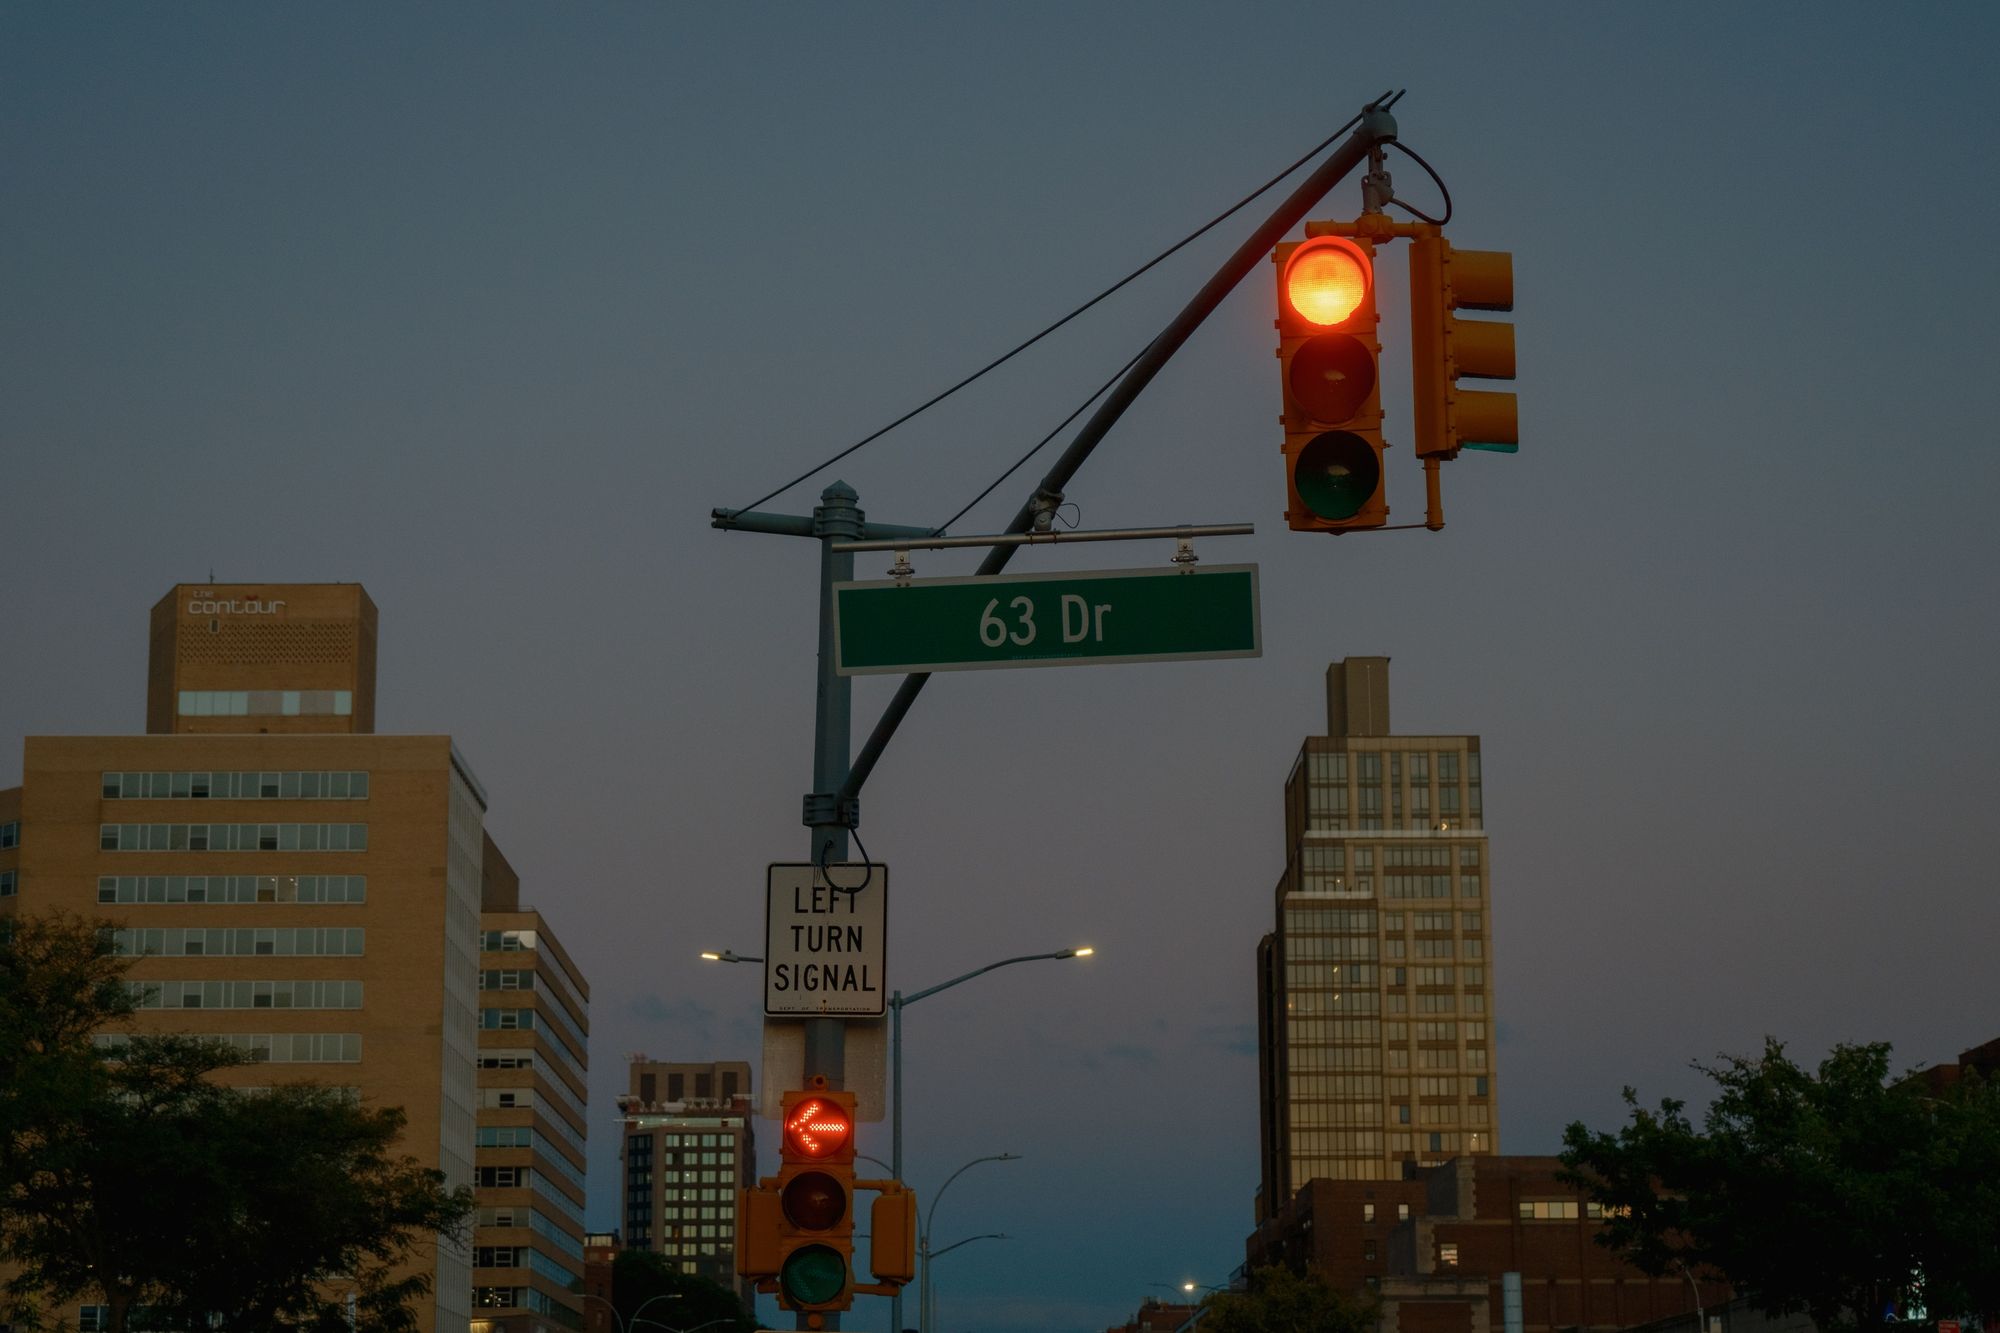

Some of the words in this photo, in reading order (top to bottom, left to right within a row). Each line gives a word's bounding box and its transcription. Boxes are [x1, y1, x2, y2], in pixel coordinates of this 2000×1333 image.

[188, 599, 286, 614] contour
[979, 595, 1037, 648] 63
[1061, 594, 1113, 644] Dr
[795, 887, 860, 914] LEFT
[791, 926, 863, 953] TURN
[774, 964, 876, 992] SIGNAL
